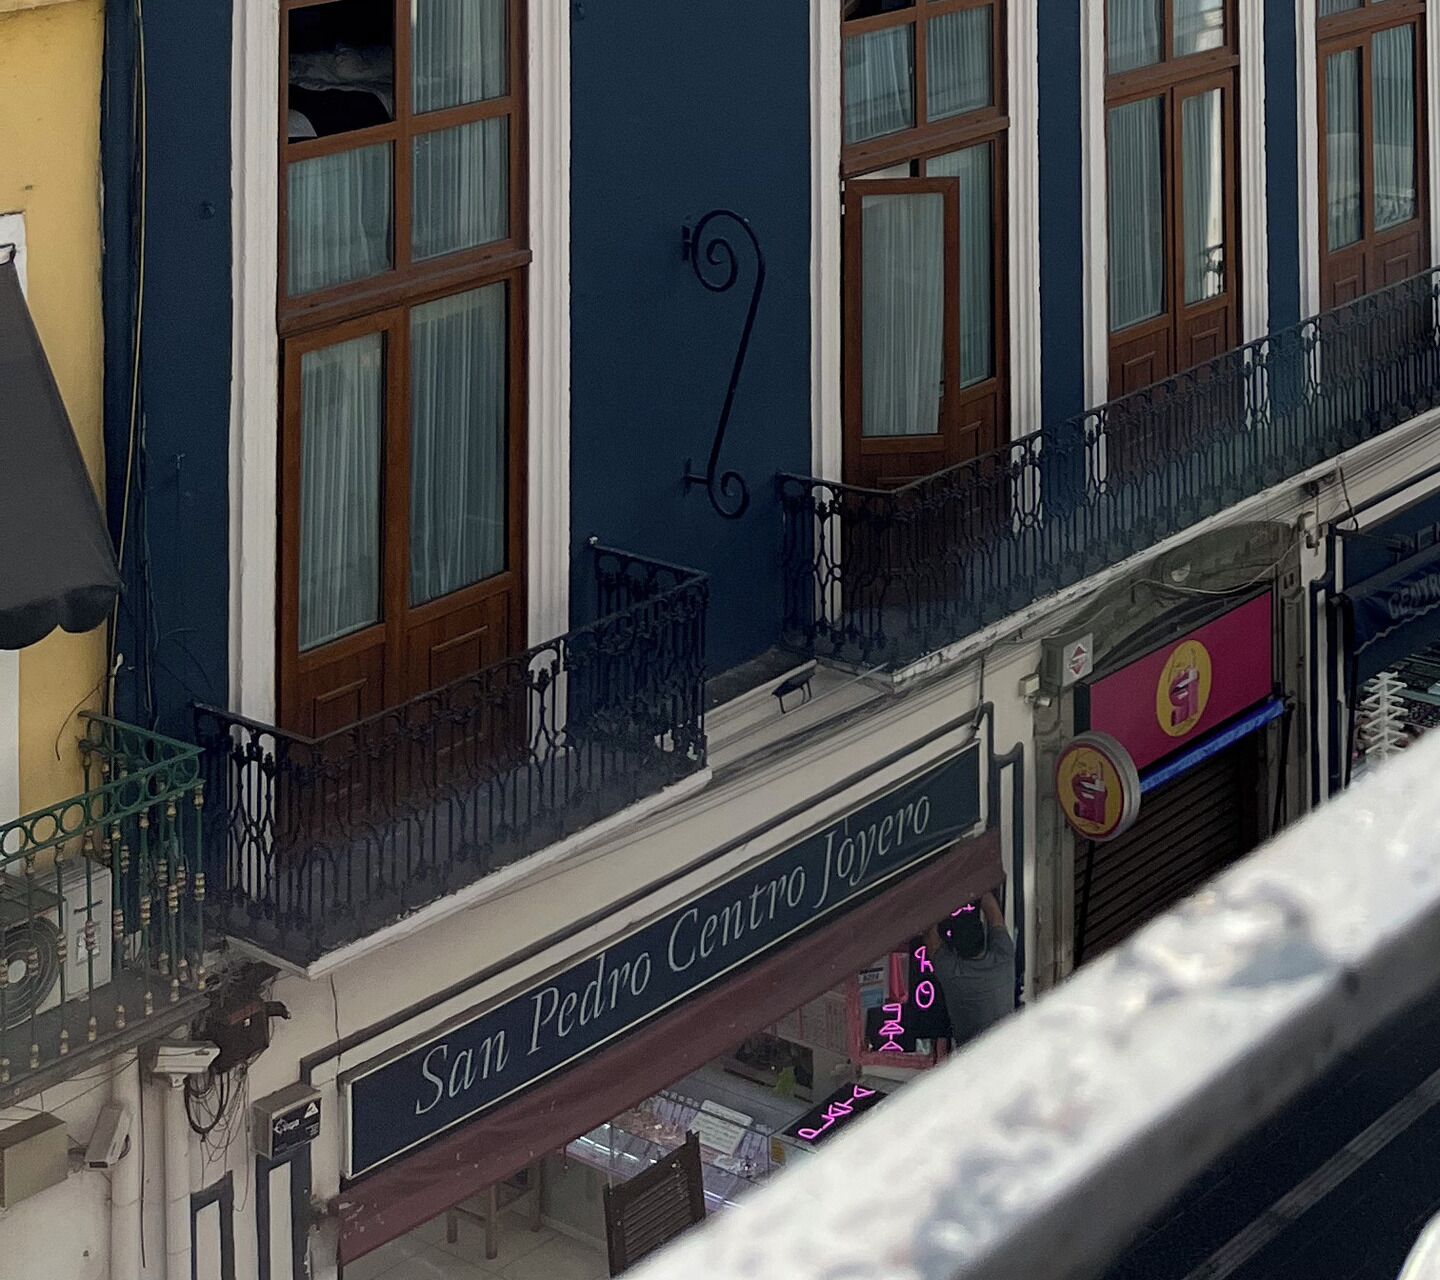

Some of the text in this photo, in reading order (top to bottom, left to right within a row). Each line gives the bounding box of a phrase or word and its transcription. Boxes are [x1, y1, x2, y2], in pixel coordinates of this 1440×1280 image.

[414, 794, 930, 1115] San Pedro Centro Joyero
